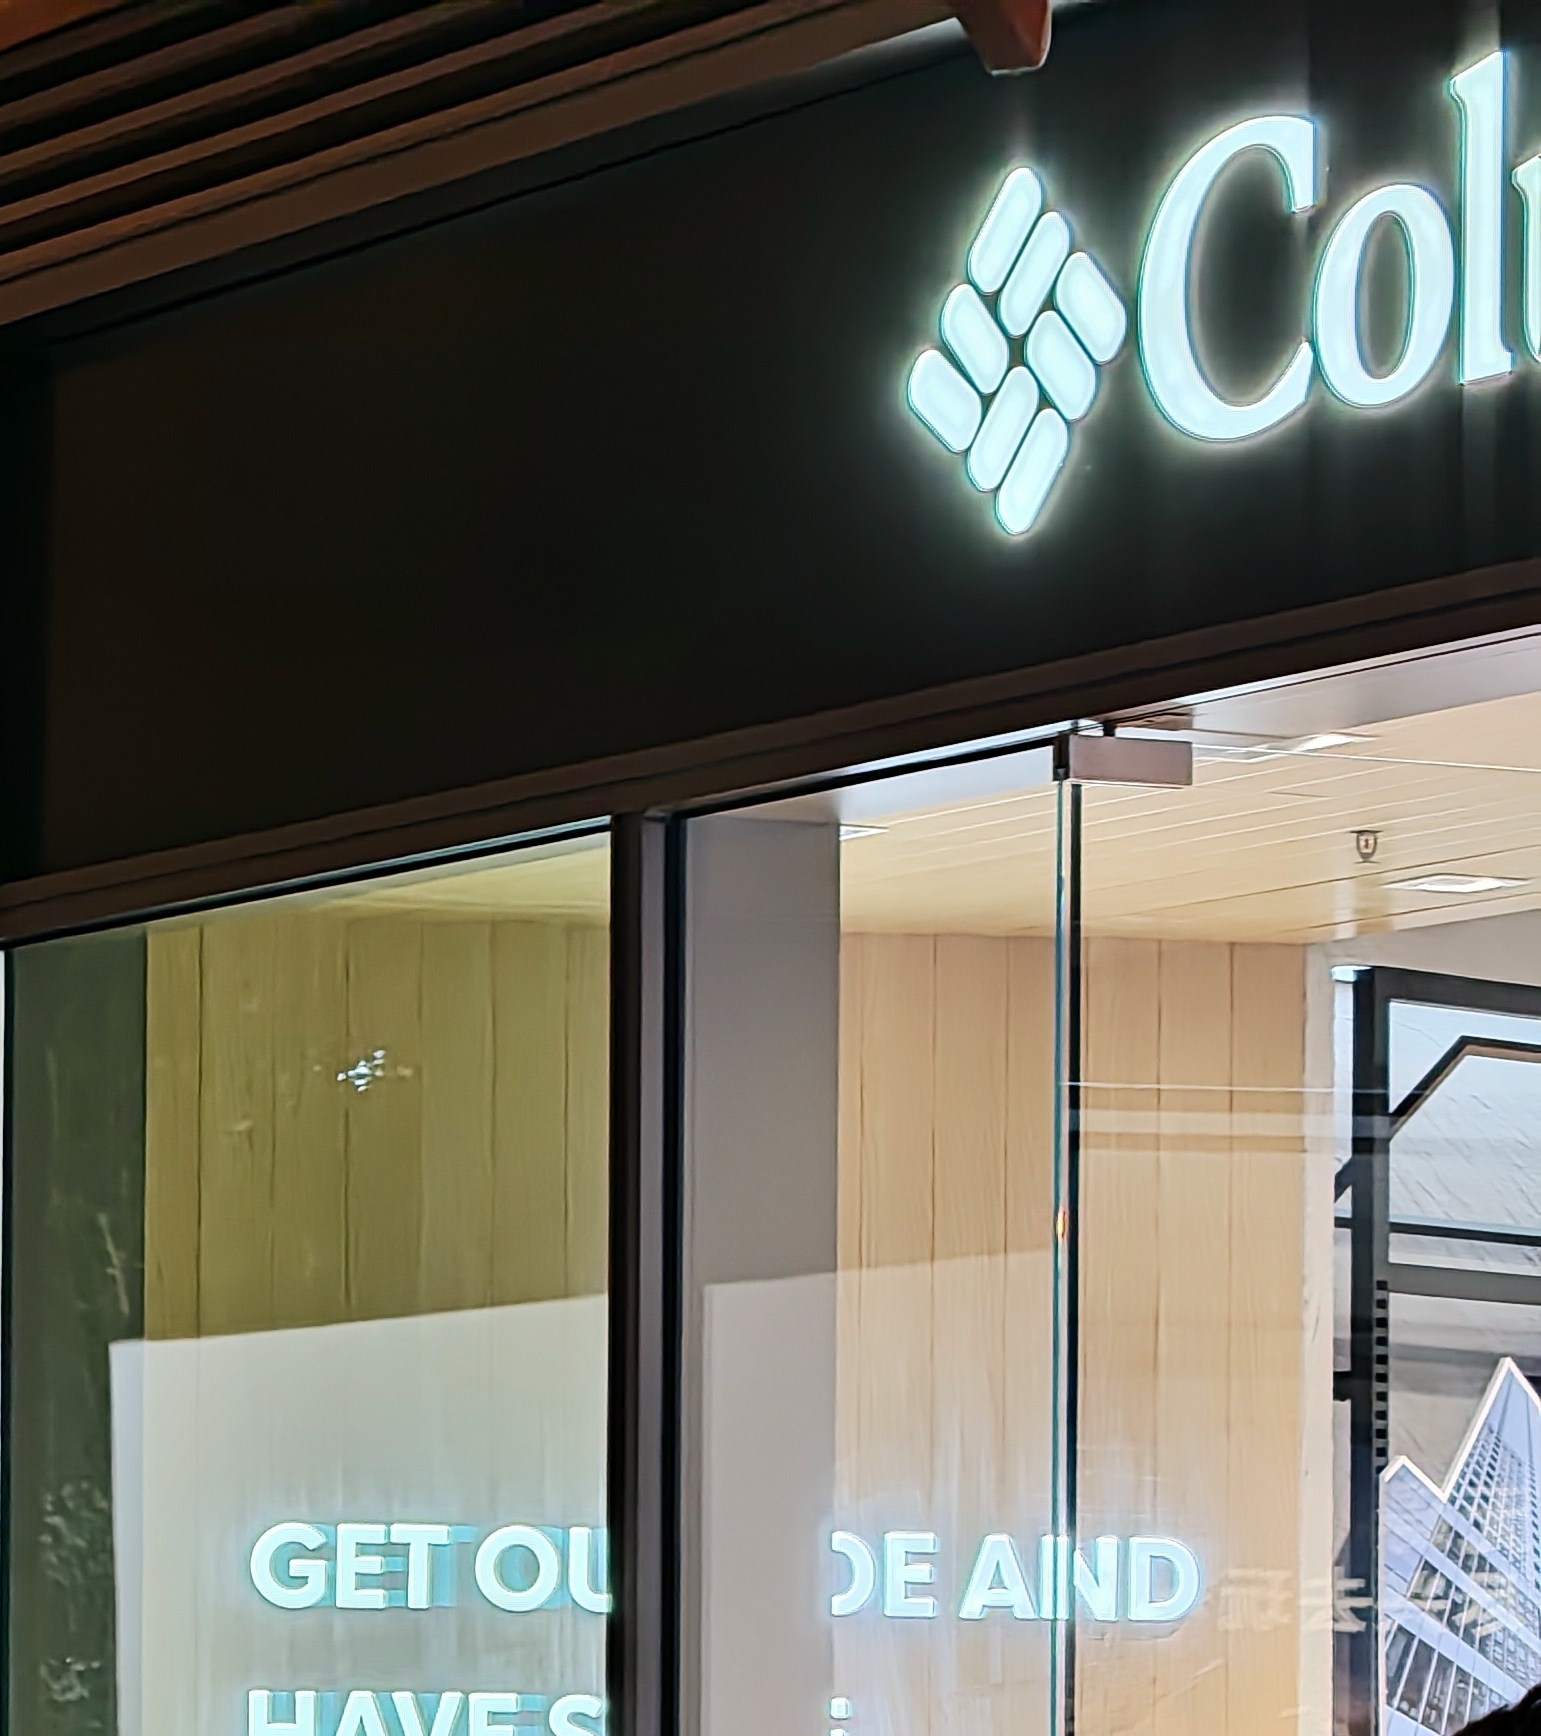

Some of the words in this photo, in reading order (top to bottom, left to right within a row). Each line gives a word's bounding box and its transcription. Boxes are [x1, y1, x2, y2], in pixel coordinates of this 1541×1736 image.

[1138, 48, 1541, 441] Col
[249, 1521, 450, 1610] GET
[958, 1533, 1203, 1622] AND
